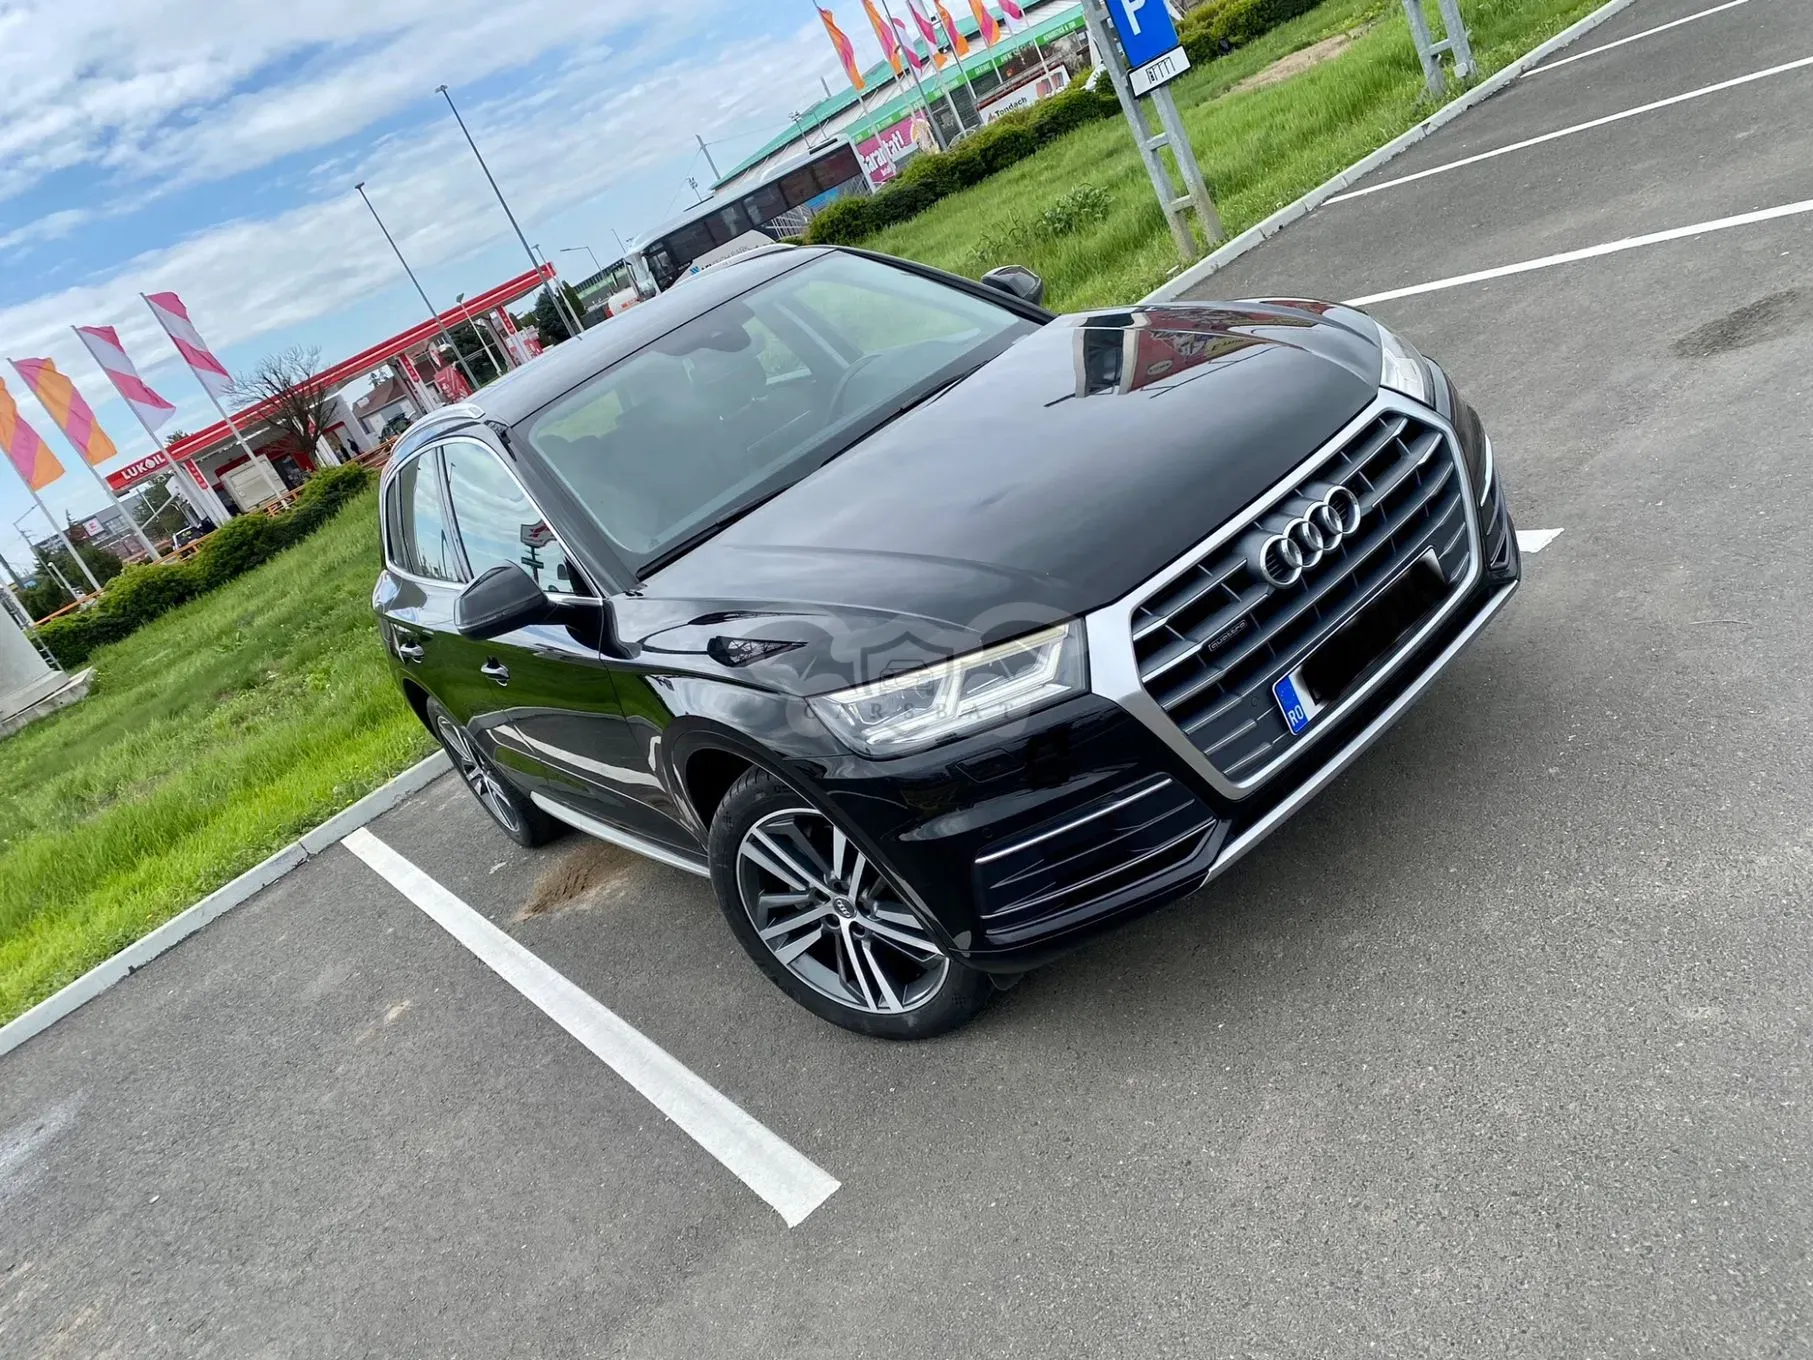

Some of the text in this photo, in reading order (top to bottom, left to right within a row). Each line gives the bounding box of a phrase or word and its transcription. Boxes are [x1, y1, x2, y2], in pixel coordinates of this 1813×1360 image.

[1122, 0, 1146, 36] P
[121, 454, 166, 480] LUKOIL
[1288, 705, 1304, 727] RO
